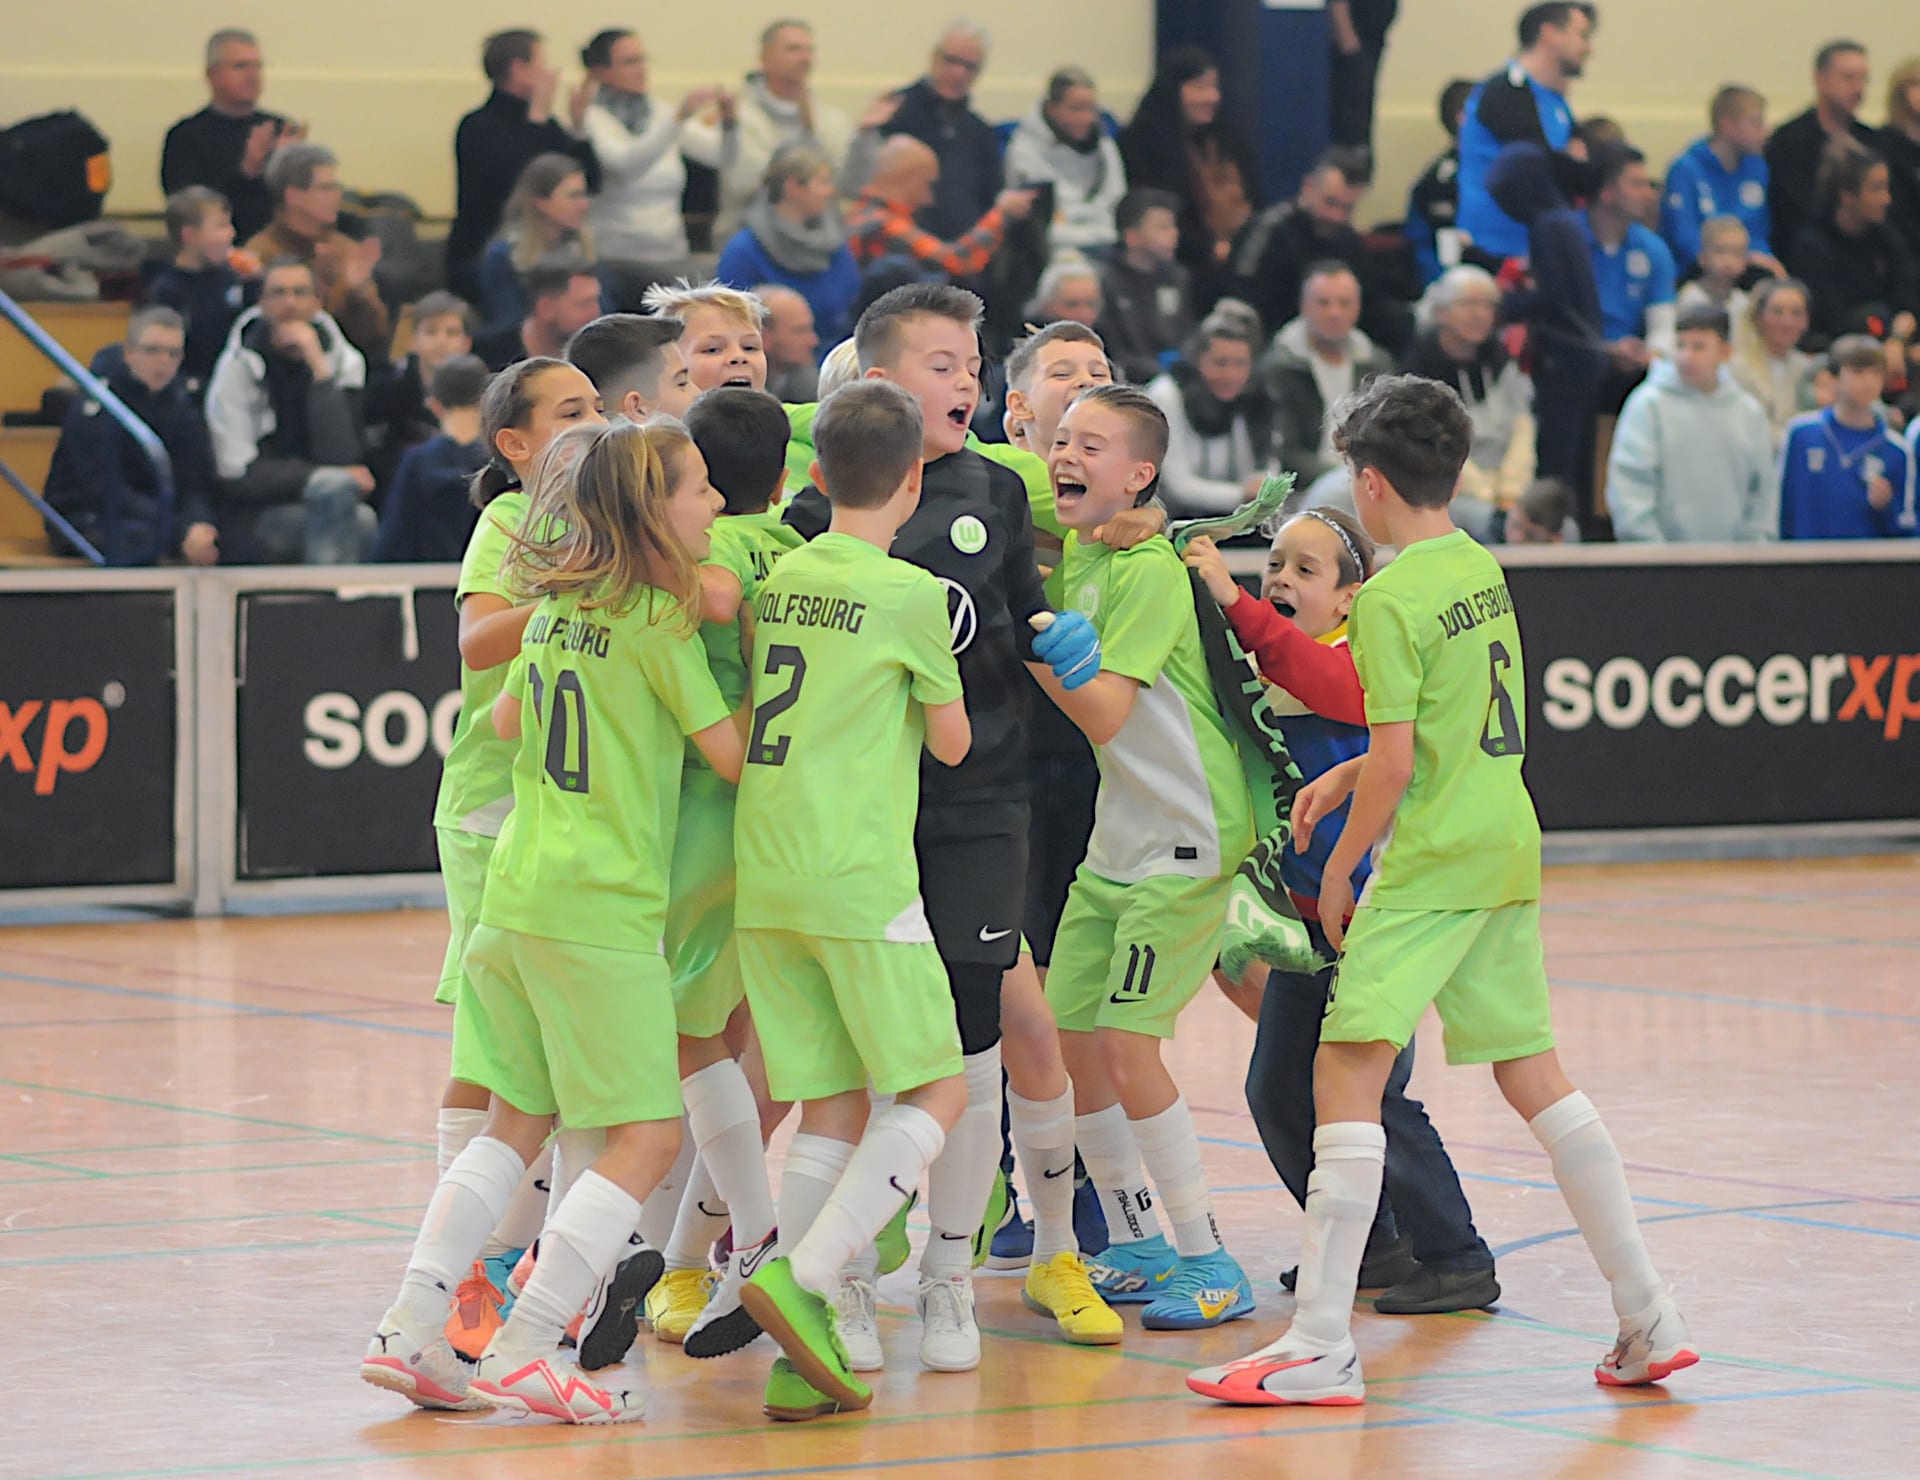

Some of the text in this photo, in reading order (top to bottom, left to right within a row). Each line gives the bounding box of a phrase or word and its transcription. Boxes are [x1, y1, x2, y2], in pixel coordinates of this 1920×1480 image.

[757, 592, 867, 635] OLFSBURG
[747, 643, 807, 767] 2
[1479, 639, 1525, 758] 6
[1122, 943, 1156, 995] 11
